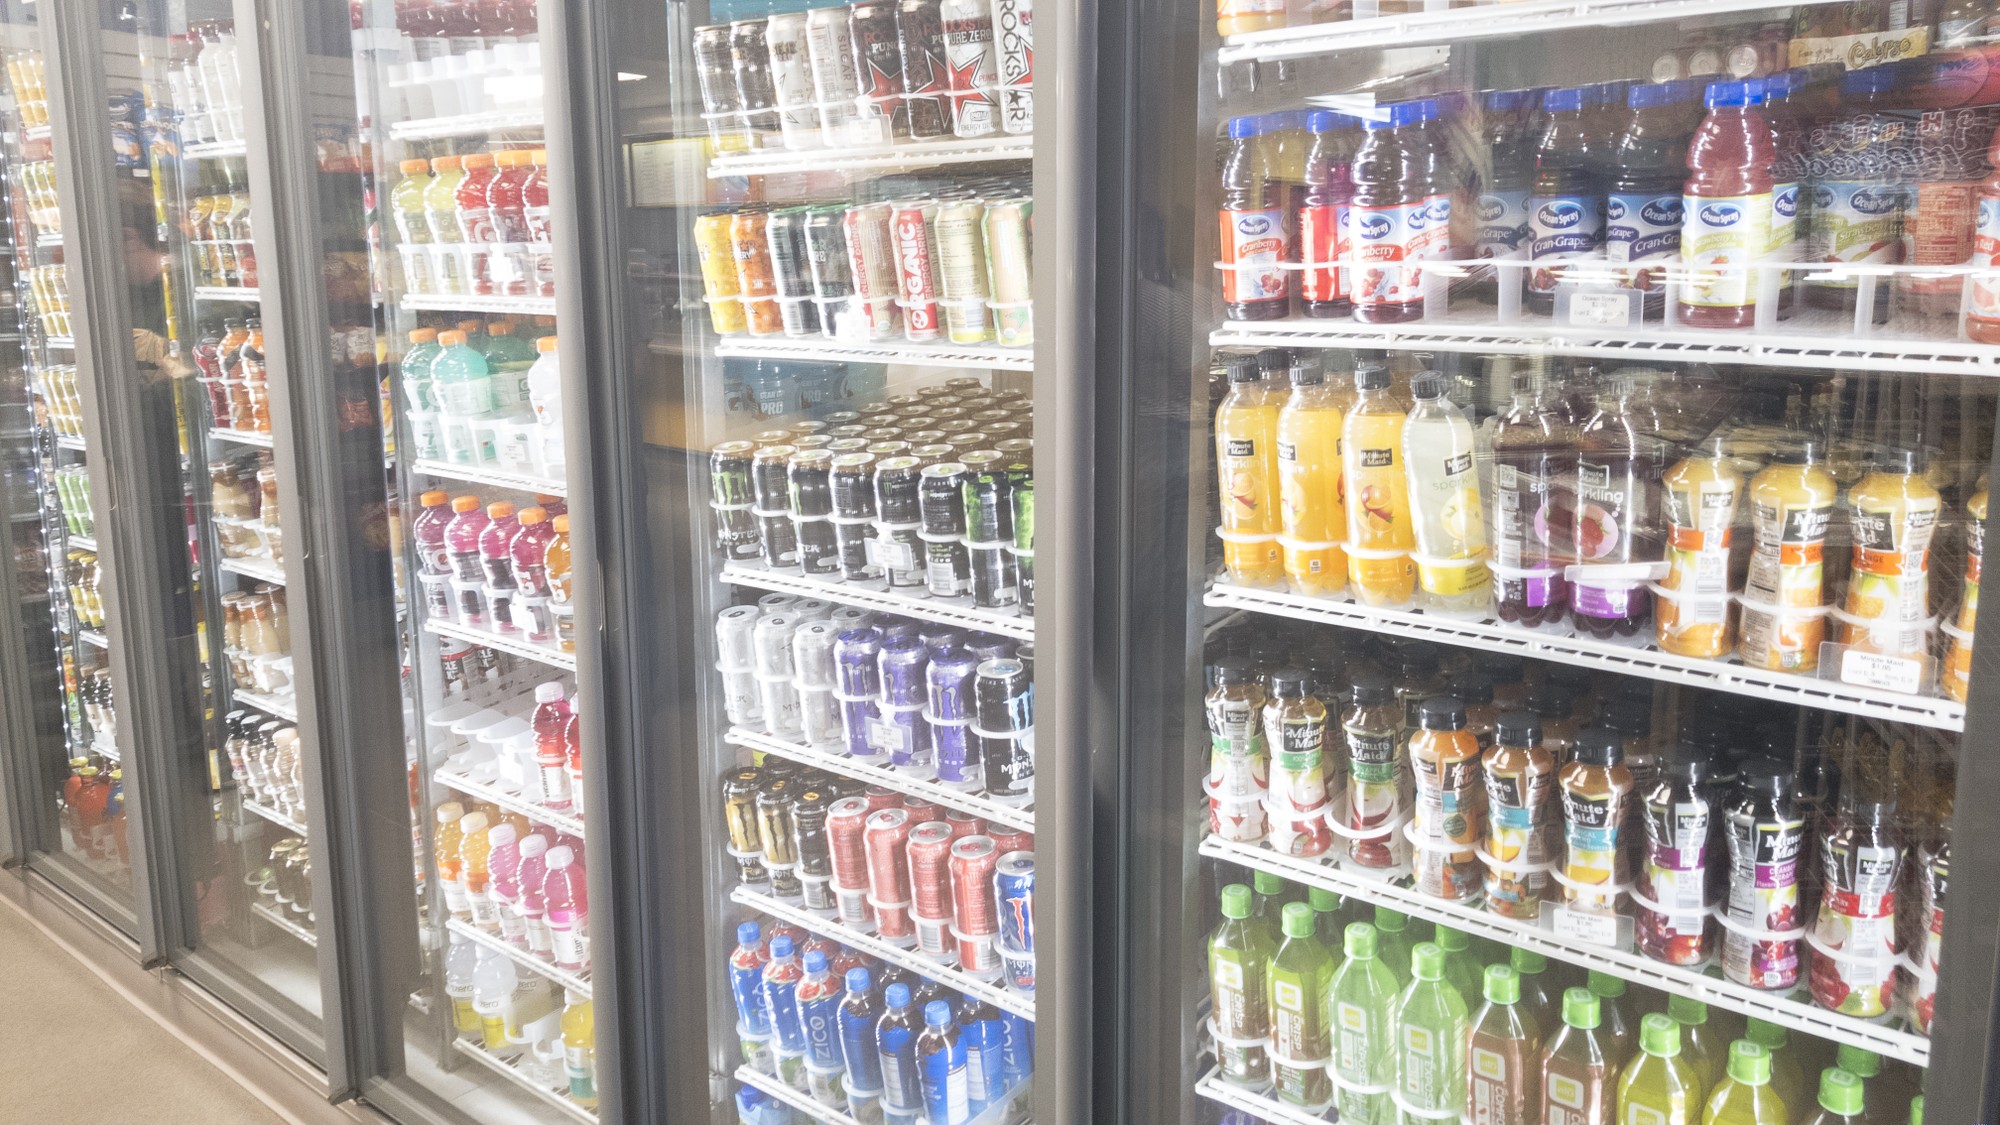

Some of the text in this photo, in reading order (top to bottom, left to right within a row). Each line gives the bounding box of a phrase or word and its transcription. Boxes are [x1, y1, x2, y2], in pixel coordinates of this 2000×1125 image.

[969, 28, 992, 43] ZERO
[871, 41, 899, 54] PUNC
[1847, 36, 1911, 70] Calypso
[838, 35, 852, 81] SUGAR
[1854, 195, 1878, 210] Ocean
[1540, 210, 1579, 225] Ocean Spray
[1644, 207, 1681, 222] Ocean Spra
[1702, 211, 1739, 225] Ocean Spray
[1370, 222, 1388, 237] Spray
[1482, 228, 1513, 241] Grape
[915, 222, 928, 255] DRINK
[1534, 235, 1587, 253] Cran-Grape
[1635, 234, 1680, 253] Cran-Gra
[1241, 240, 1277, 253] Cranberry
[1363, 246, 1395, 259] nberry
[760, 401, 784, 416] PRO
[1364, 451, 1391, 460] Minute
[1367, 457, 1387, 465] Maid
[1432, 472, 1475, 492] sparklin
[1582, 489, 1624, 504] rkling
[1793, 510, 1831, 527] Minu
[1226, 711, 1248, 719] Minute
[1765, 832, 1801, 849] Minu
[1234, 992, 1245, 1030] CRISP
[809, 1015, 831, 1060] ZICO
[1292, 1014, 1304, 1051] CRISP
[1495, 1085, 1507, 1125] COMFO
